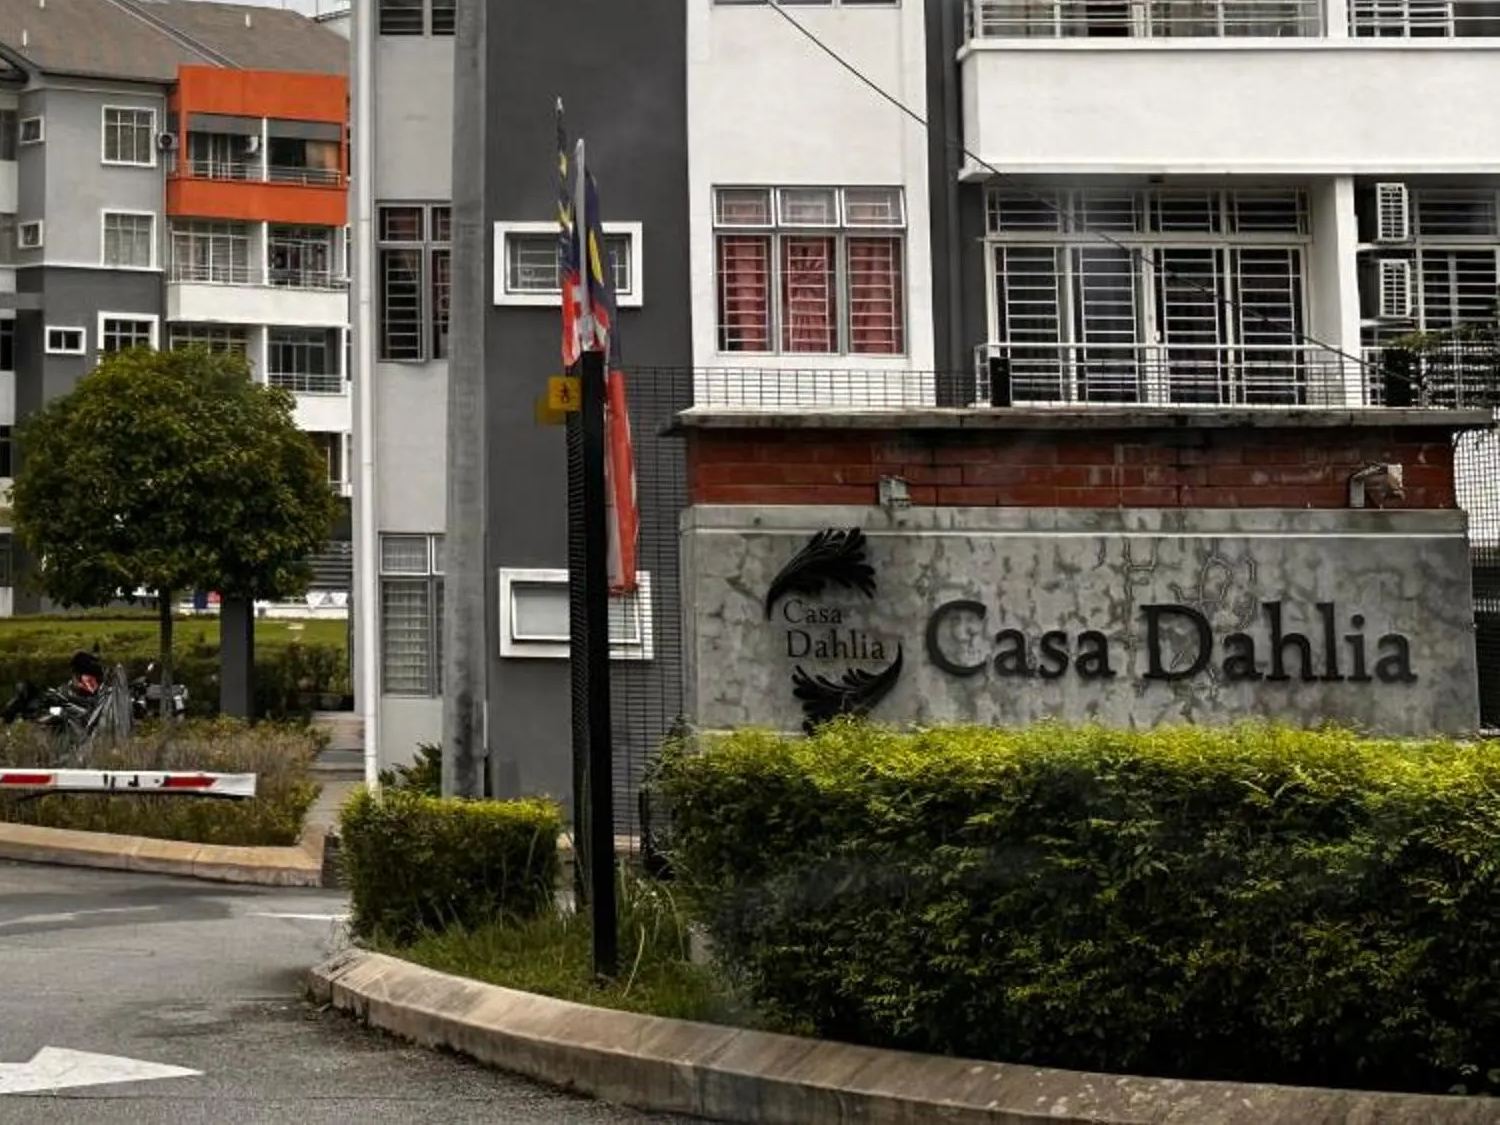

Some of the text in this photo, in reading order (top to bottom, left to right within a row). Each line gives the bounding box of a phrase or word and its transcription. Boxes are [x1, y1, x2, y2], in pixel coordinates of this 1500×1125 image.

[783, 599, 842, 624] Casa
[787, 629, 886, 660] Dahlia
[926, 599, 1419, 684] Casa Dahlia
